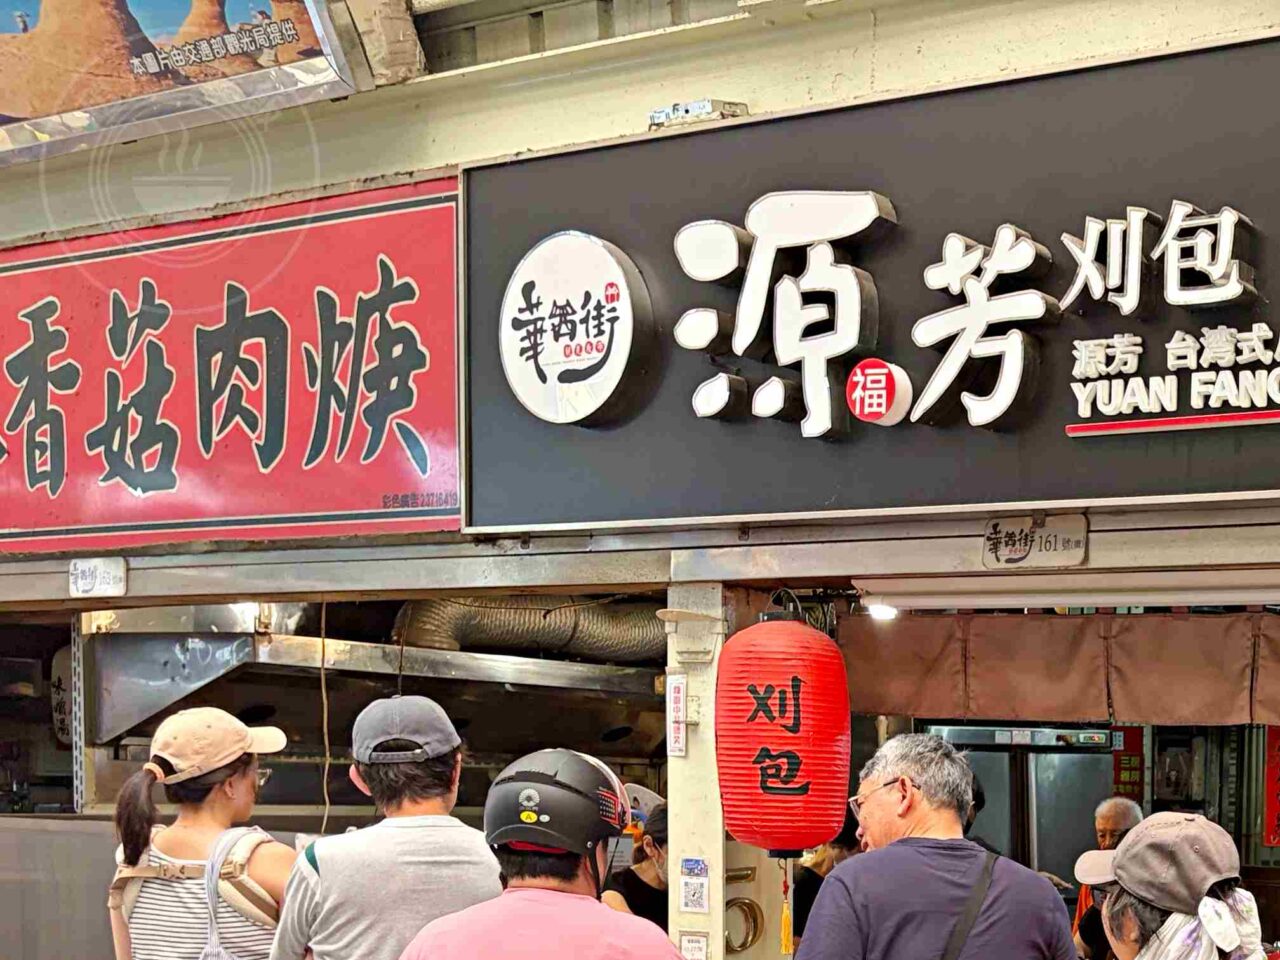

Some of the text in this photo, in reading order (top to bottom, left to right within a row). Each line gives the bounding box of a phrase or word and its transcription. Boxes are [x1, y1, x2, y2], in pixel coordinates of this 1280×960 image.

[130, 19, 299, 77] 本圖片由交通部觀光局提供
[672, 189, 1246, 438] 源芳 福 刈包
[1071, 331, 1144, 379] 源芳
[1070, 371, 1180, 419] YUAN
[745, 675, 812, 798] 刈包
